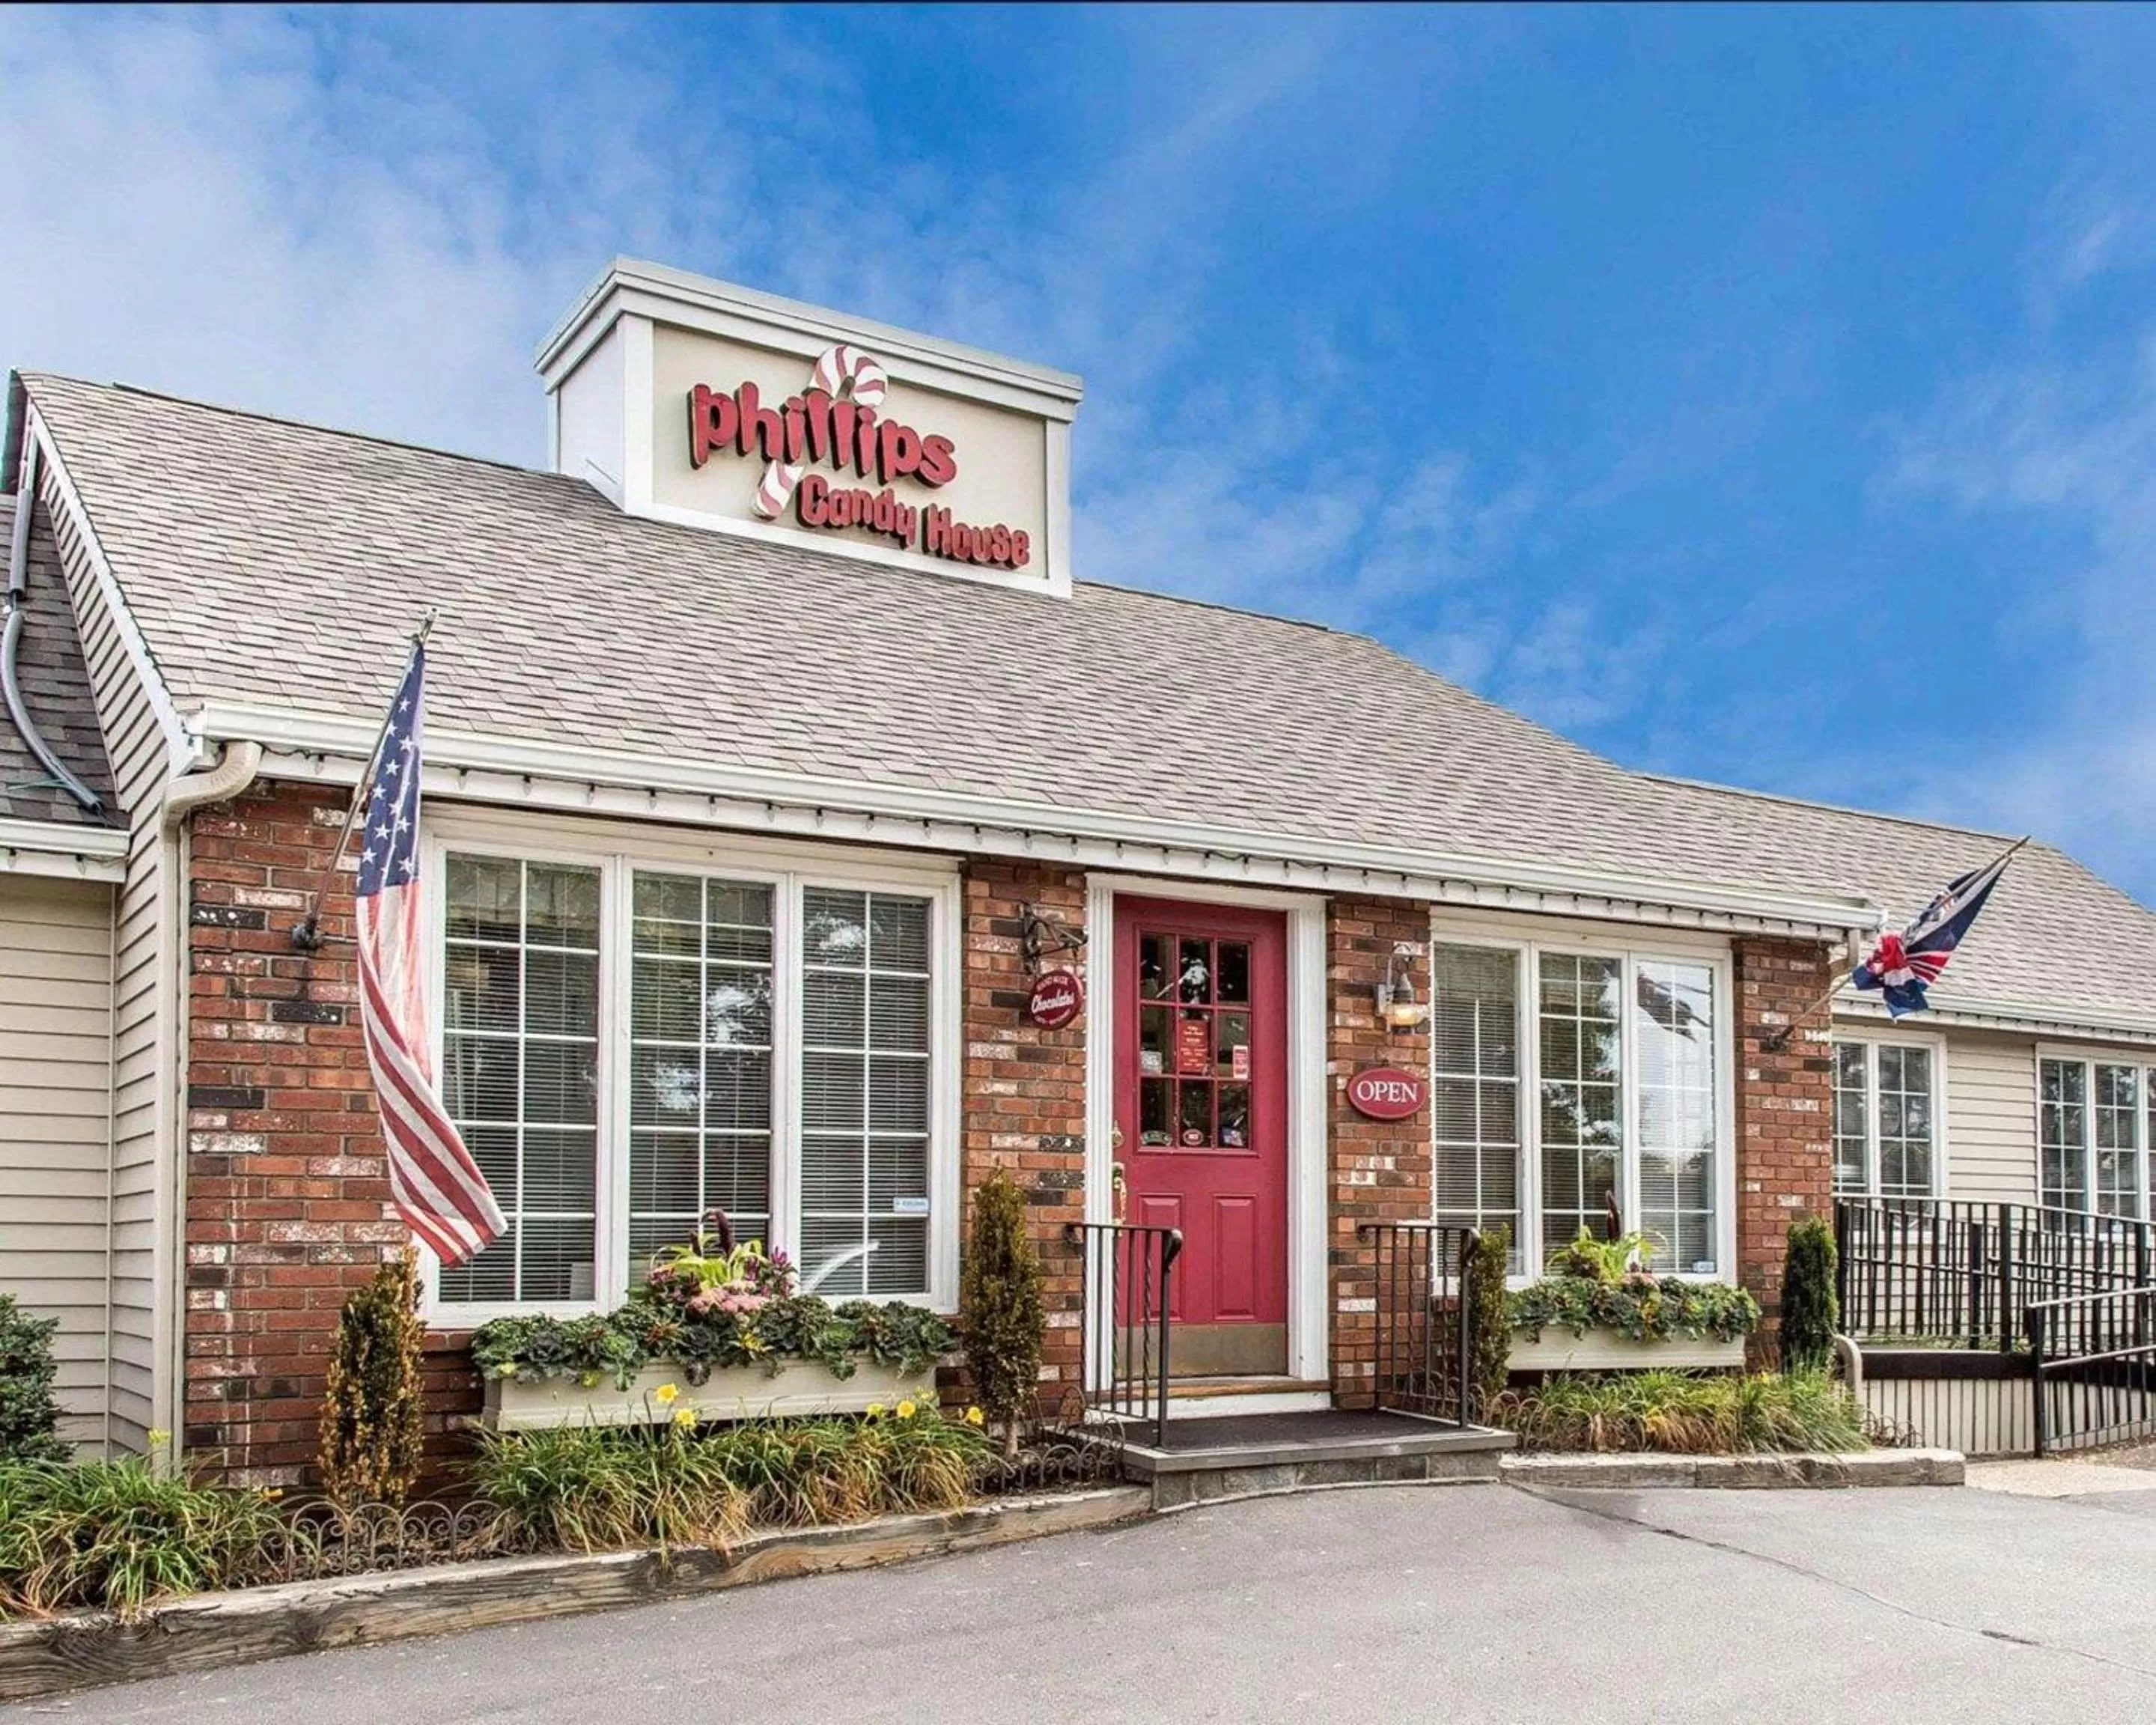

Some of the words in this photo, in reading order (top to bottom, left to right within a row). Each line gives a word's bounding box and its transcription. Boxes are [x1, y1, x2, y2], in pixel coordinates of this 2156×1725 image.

[688, 381, 957, 487] phillips
[797, 474, 916, 549] Candy
[922, 503, 1030, 569] House
[1356, 1080, 1418, 1103] OPEN
